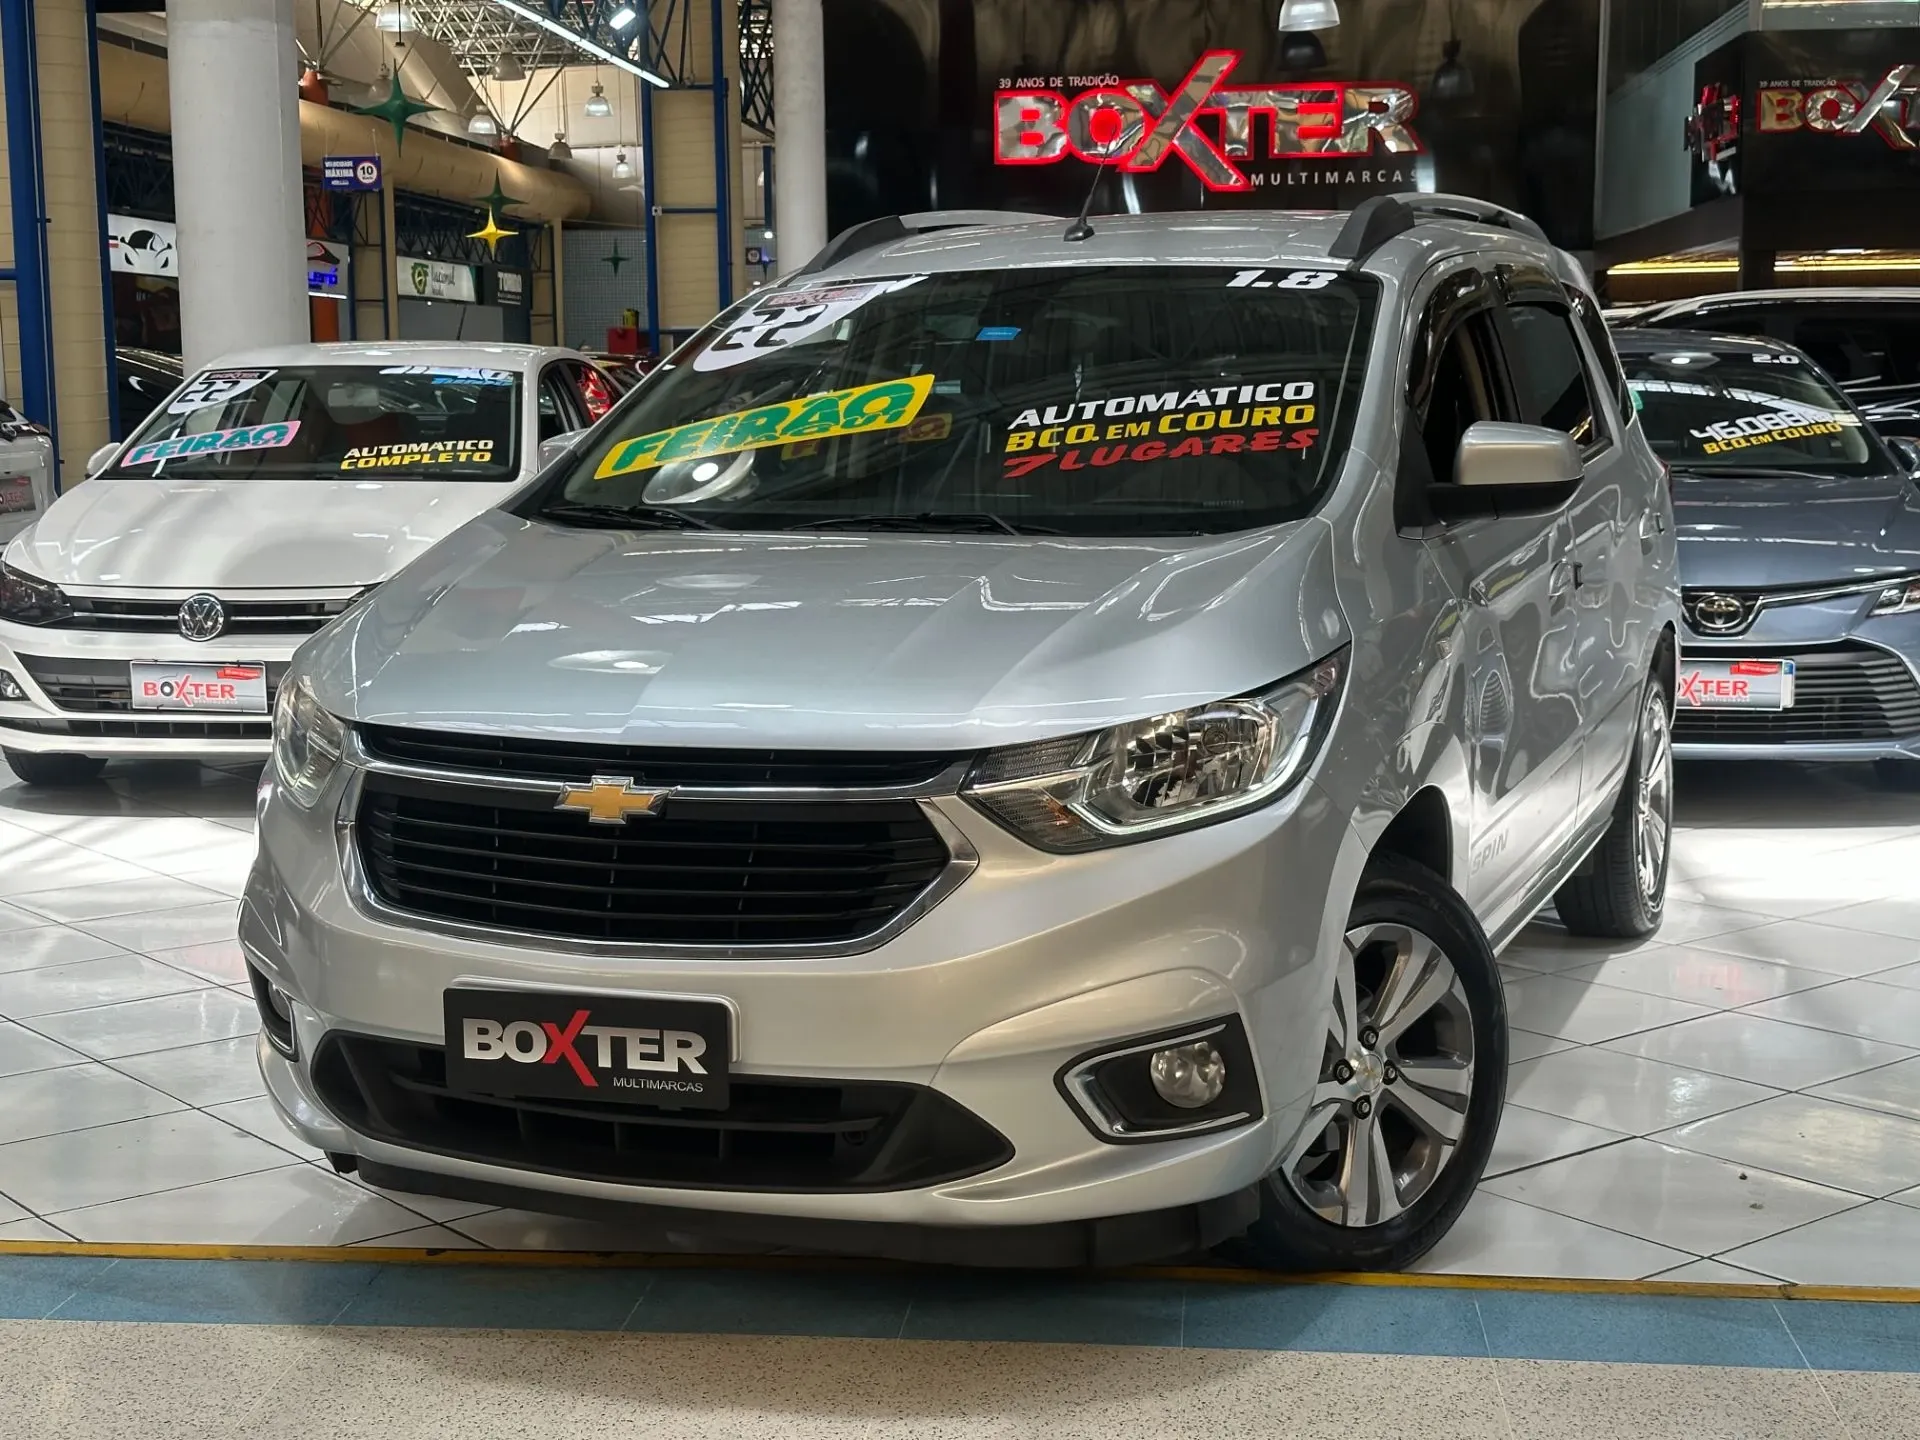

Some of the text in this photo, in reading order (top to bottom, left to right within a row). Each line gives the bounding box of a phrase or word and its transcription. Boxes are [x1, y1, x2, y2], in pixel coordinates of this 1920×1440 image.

[998, 72, 1120, 90] 39 ANOS DE TRADIÇÃO
[994, 49, 1425, 191] BOXTER
[360, 166, 374, 176] 10
[1250, 169, 1418, 187] MULTIMARCAS
[1224, 269, 1339, 290] 1.8
[1751, 353, 1800, 365] 2.0
[176, 380, 241, 403] 22
[1105, 421, 1151, 441] EM
[1157, 404, 1316, 434] COURO
[1752, 435, 1772, 446] EM
[1772, 422, 1843, 441] COURO
[340, 451, 492, 471] COMPLETO
[1003, 428, 1320, 479] 7 LUGARES
[143, 674, 236, 707] BOXTER
[1679, 670, 1750, 706] XTER
[1470, 828, 1510, 877] SPIN
[463, 1010, 708, 1087] BOXTER
[613, 1076, 704, 1093] MULTIMARCAS
